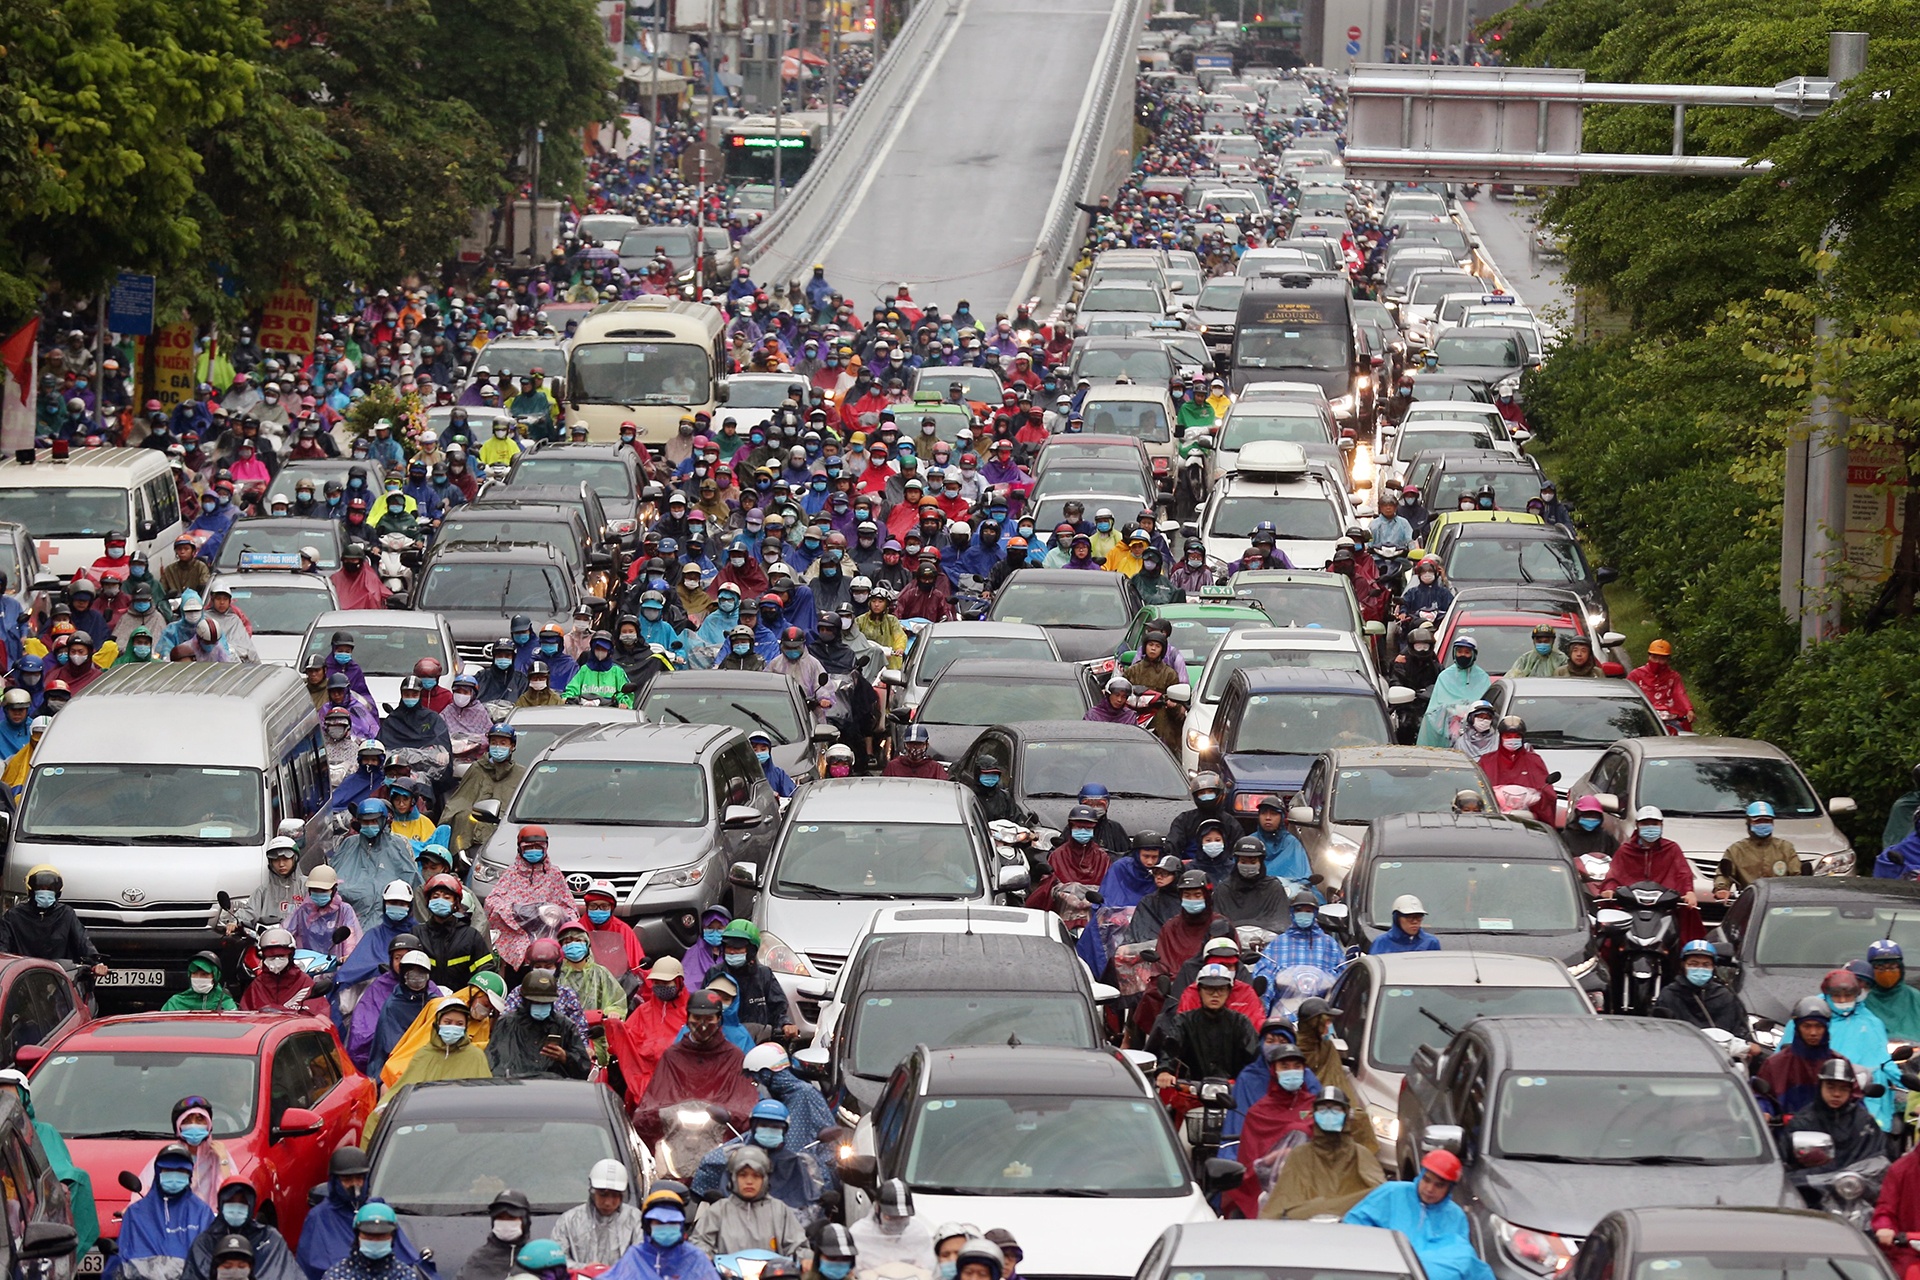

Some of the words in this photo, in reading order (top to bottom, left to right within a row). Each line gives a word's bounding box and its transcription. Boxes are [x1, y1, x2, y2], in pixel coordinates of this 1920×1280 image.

[1265, 312, 1321, 320] LIMOUSINE
[263, 554, 280, 563] SÔNG
[281, 554, 299, 565] NHUỆ
[1204, 587, 1231, 595] TAXI
[581, 683, 617, 695] Salonpa
[97, 972, 163, 985] 29B-179.49
[475, 975, 489, 986] Grab
